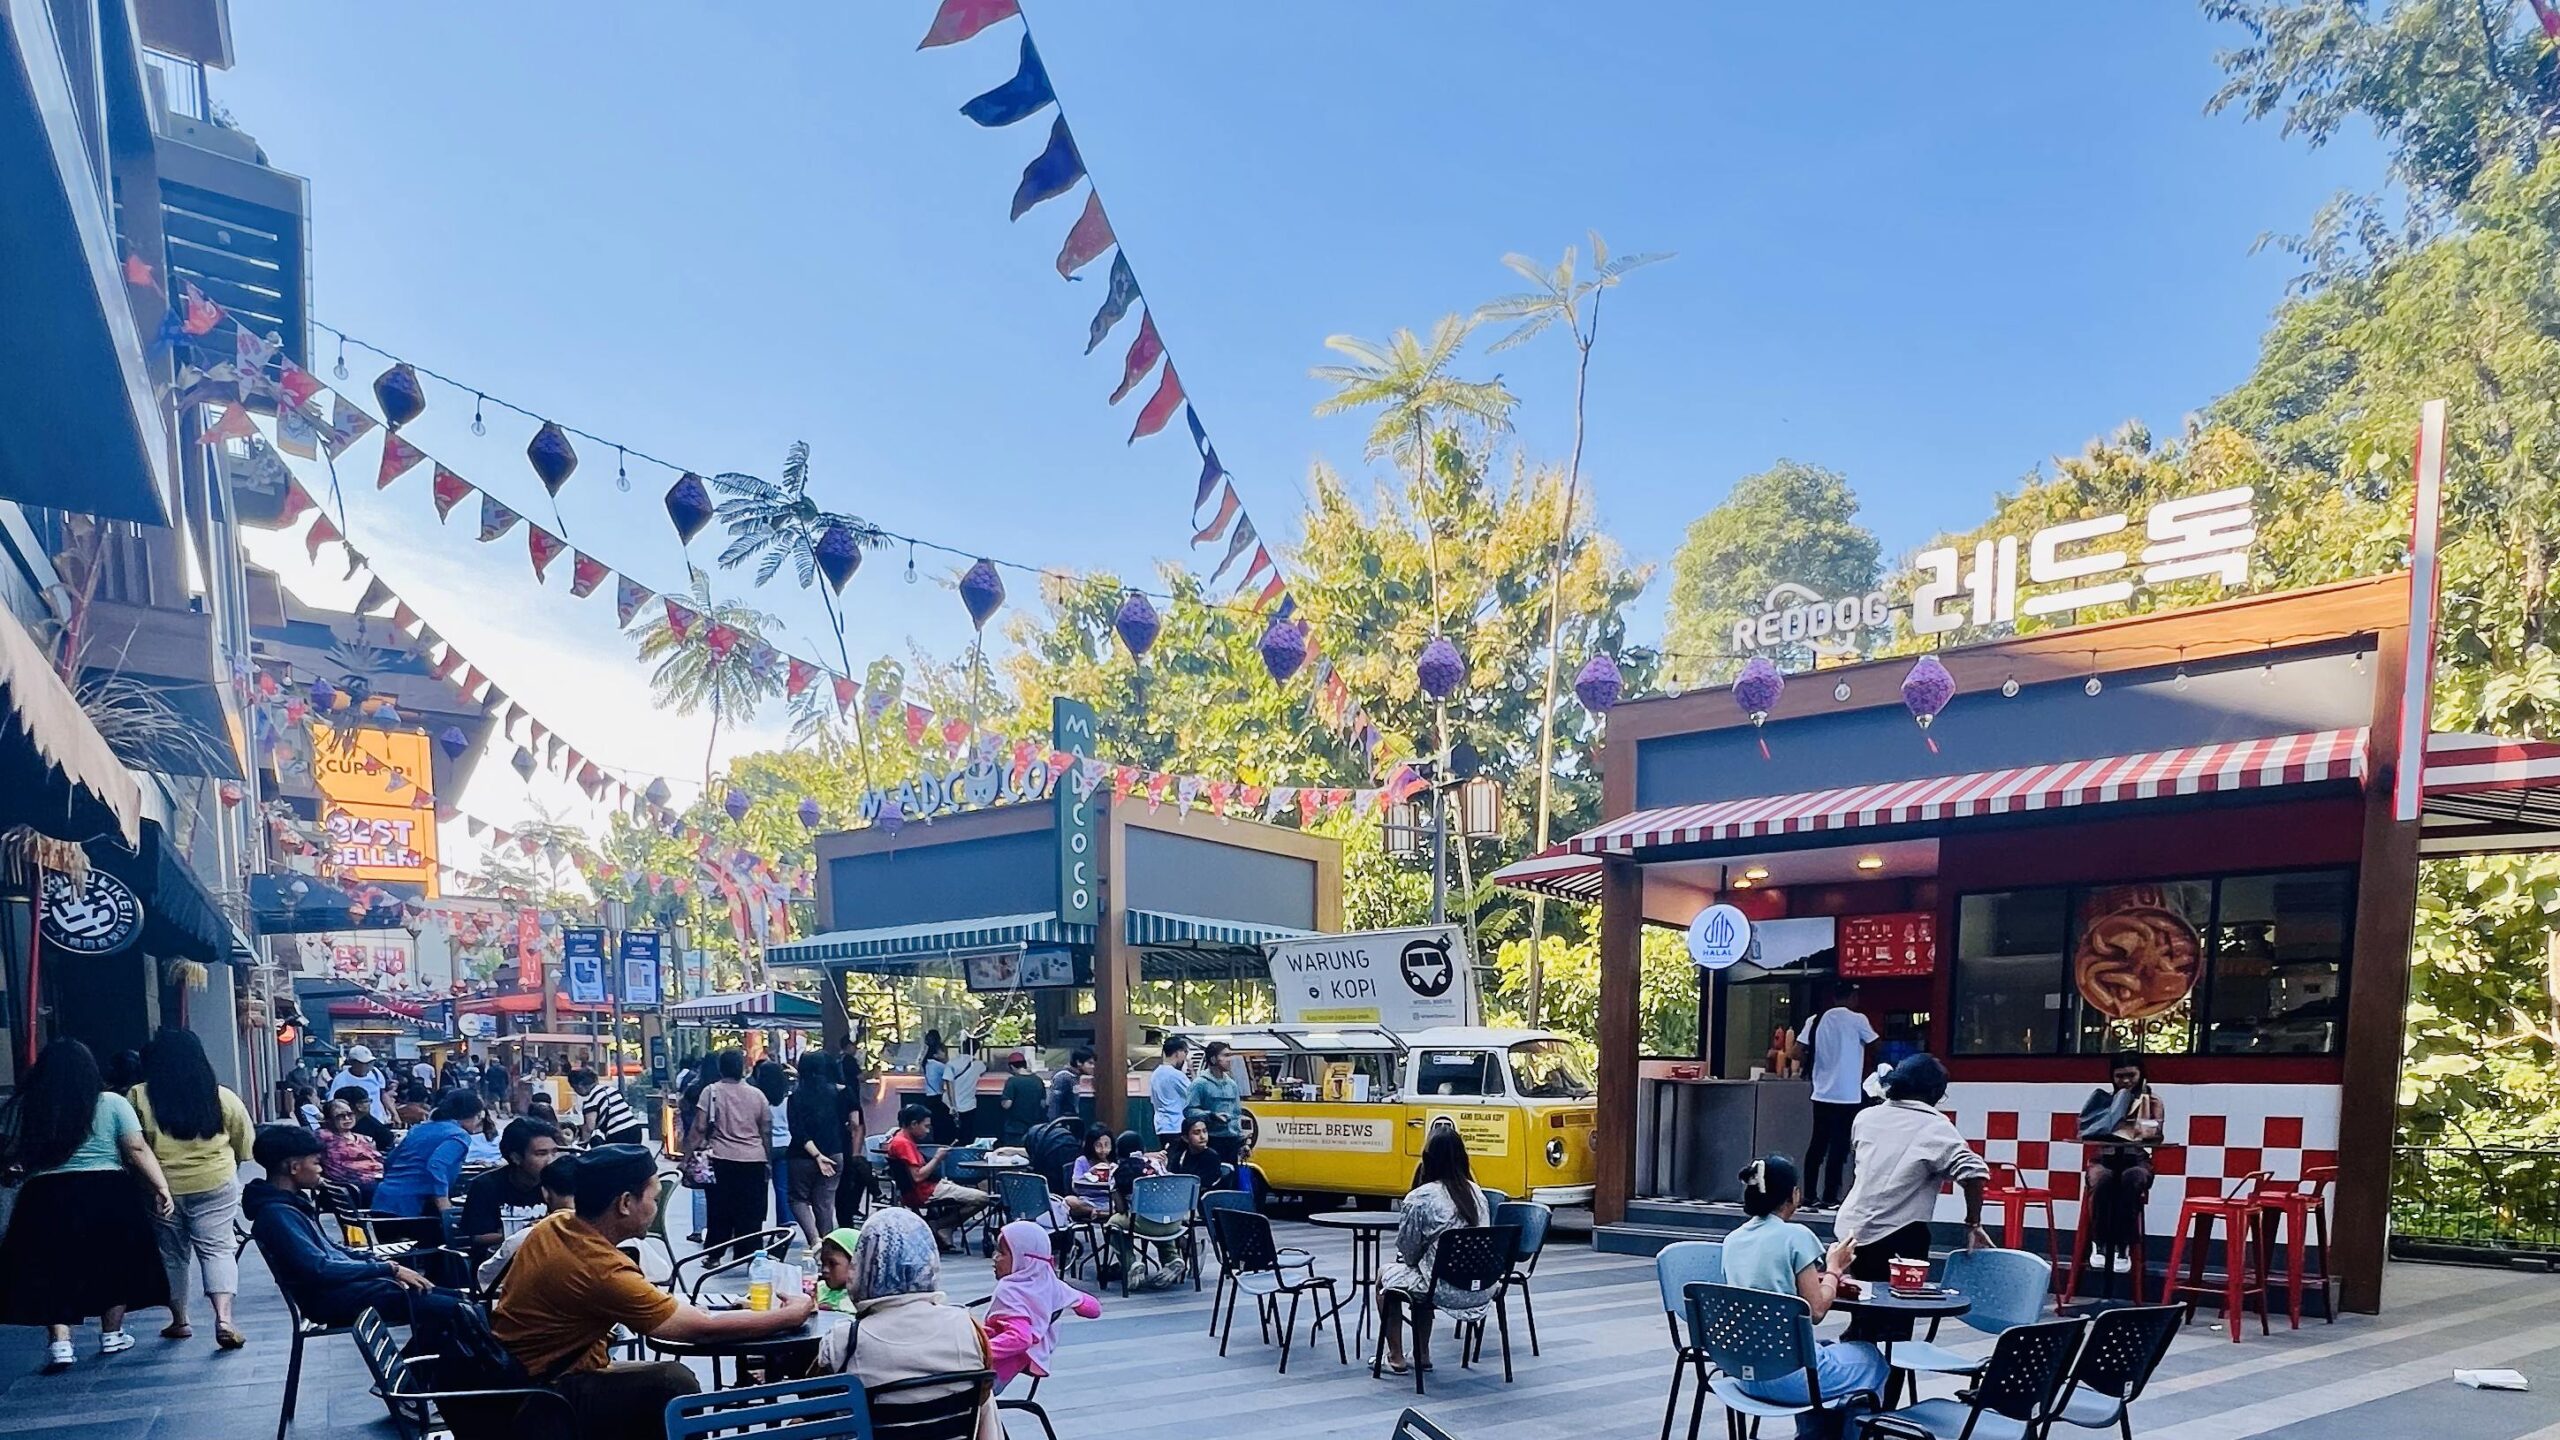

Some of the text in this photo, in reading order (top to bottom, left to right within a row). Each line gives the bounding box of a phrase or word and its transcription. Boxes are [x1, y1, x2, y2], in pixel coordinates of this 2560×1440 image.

[1912, 486, 2256, 634] 레드독
[1732, 591, 1889, 652] REDDOG
[326, 759, 404, 776] CUPP
[1065, 714, 1091, 911] MADCOCO
[326, 815, 415, 847] BEST
[1286, 950, 1370, 972] WARUNG
[1331, 978, 1377, 999] KOPI
[1276, 1122, 1373, 1137] WHEEL BREWS
